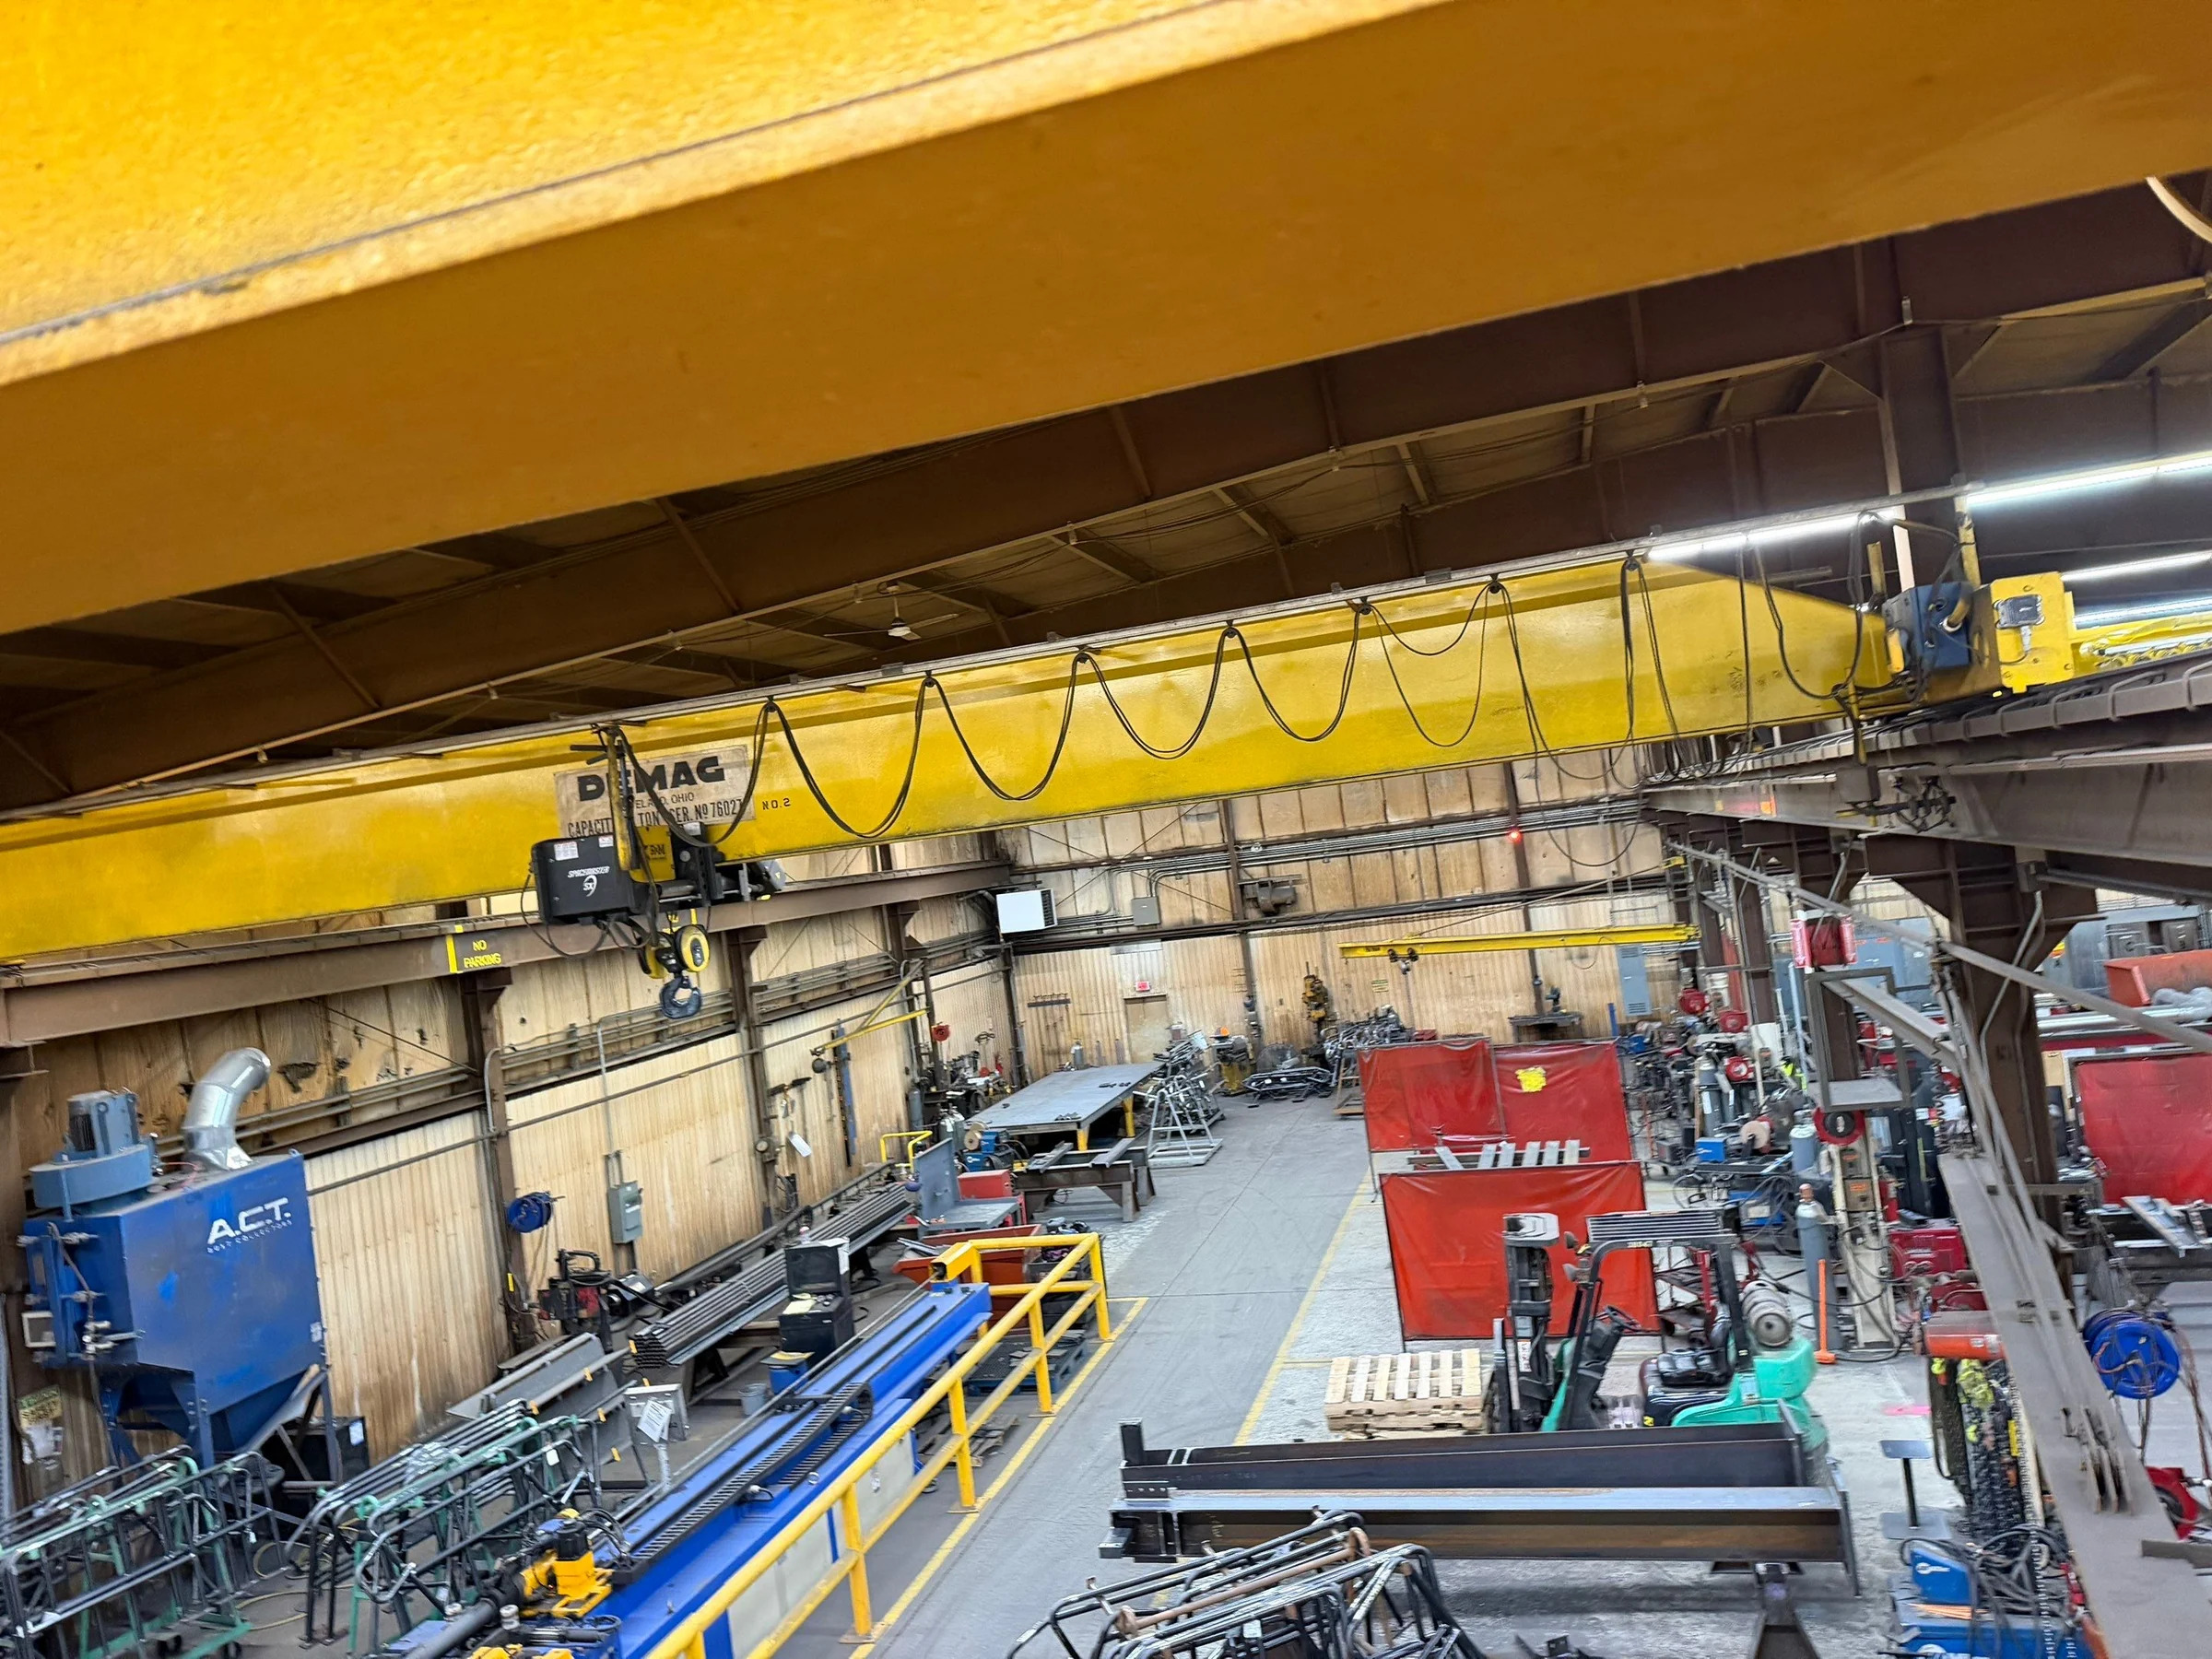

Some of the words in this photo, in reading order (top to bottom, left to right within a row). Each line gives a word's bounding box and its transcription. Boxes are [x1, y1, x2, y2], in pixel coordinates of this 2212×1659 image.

[671, 793, 695, 804] OHIO
[568, 817, 613, 837] CAPACIT
[473, 939, 488, 951] NO
[464, 952, 502, 969] PARKING
[207, 1197, 292, 1245] A.C.T.
